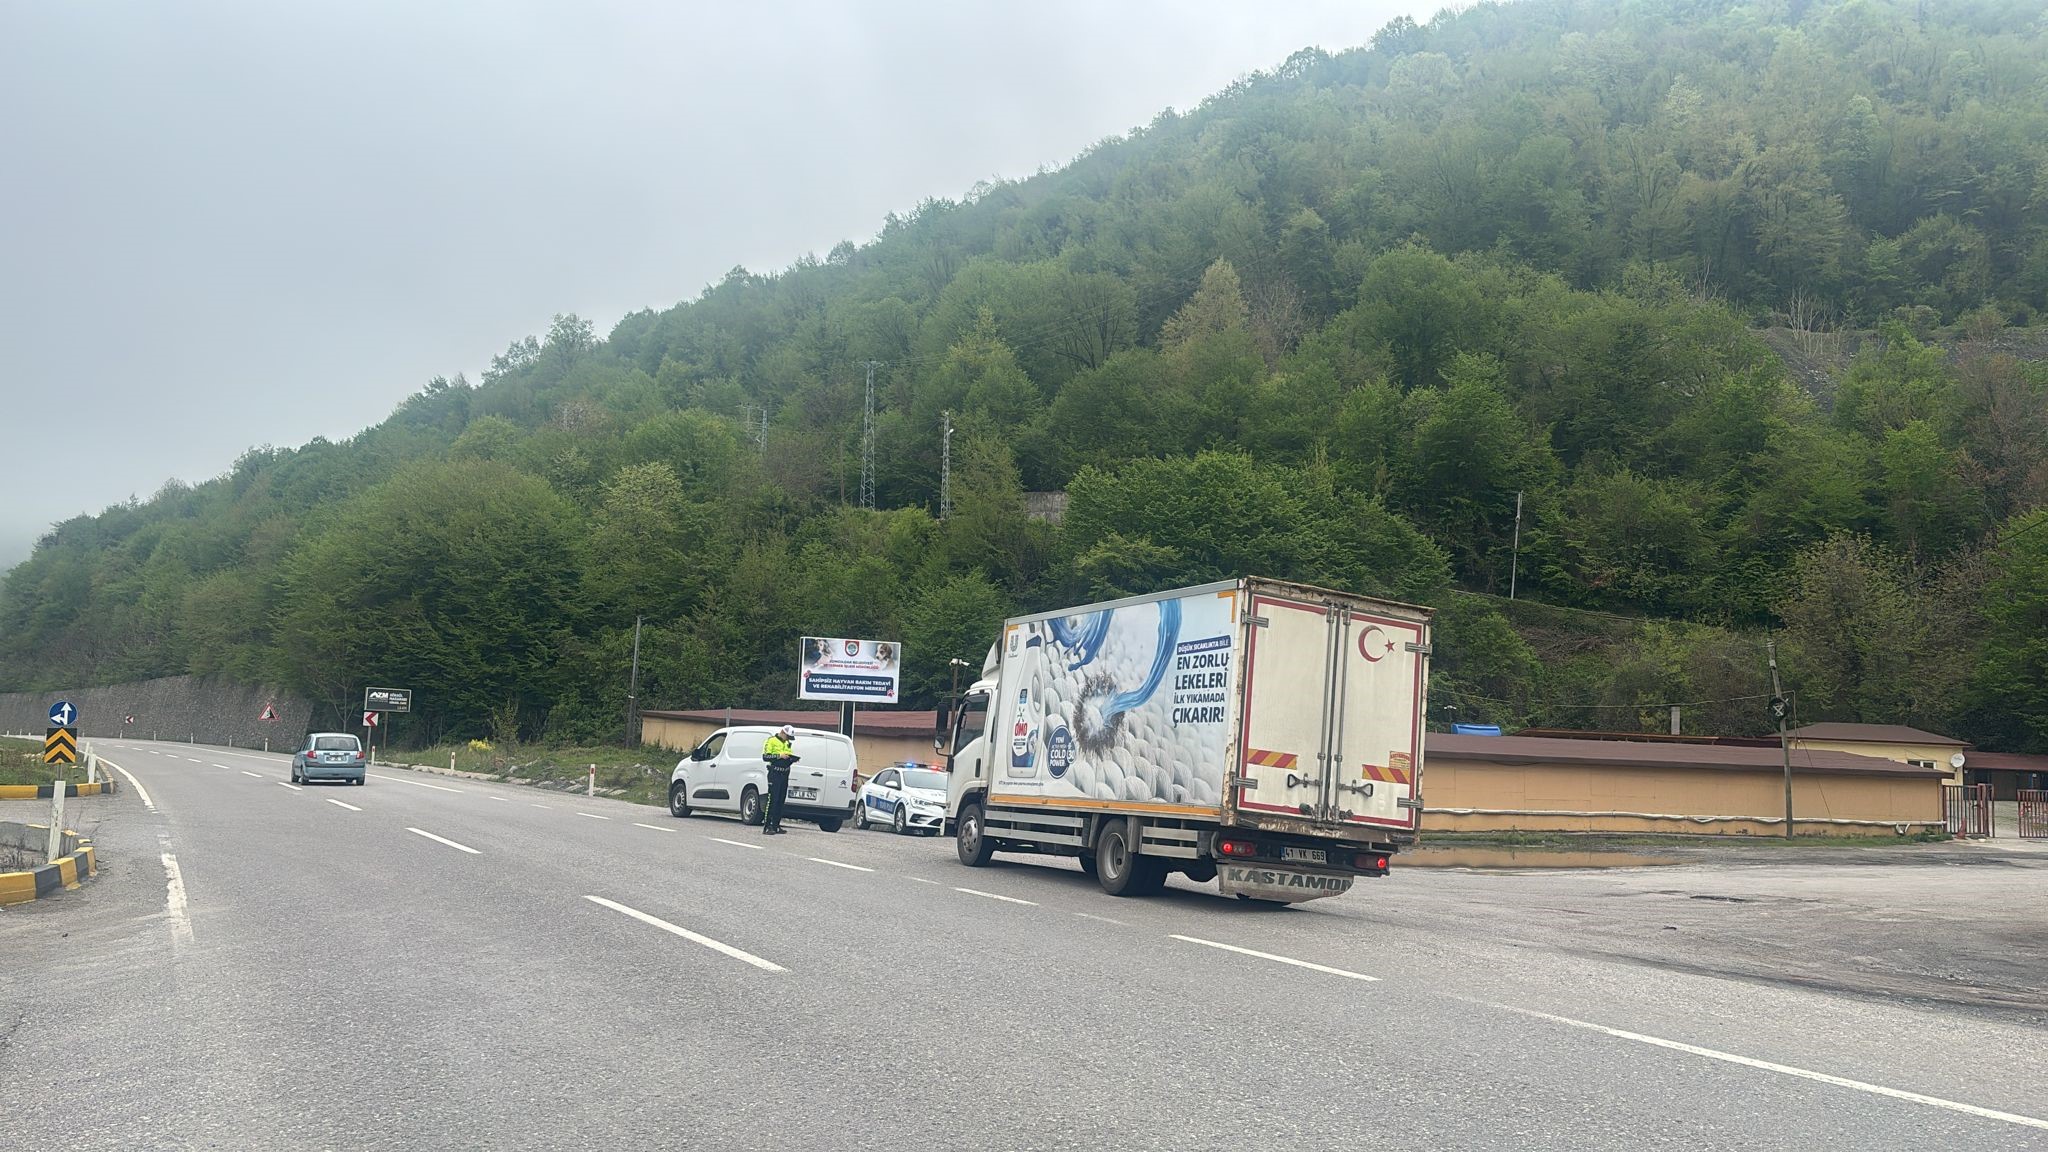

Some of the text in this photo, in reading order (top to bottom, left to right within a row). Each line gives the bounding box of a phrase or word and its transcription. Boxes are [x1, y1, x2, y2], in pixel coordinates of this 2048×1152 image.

[1177, 652, 1229, 670] EN ZORLU
[1175, 668, 1228, 690] LEKELERİ
[1174, 692, 1225, 704] İLK YIKAMADA
[1172, 706, 1225, 728] ÇIKARIR!
[1050, 749, 1066, 758] COLD
[1312, 850, 1325, 861] 669
